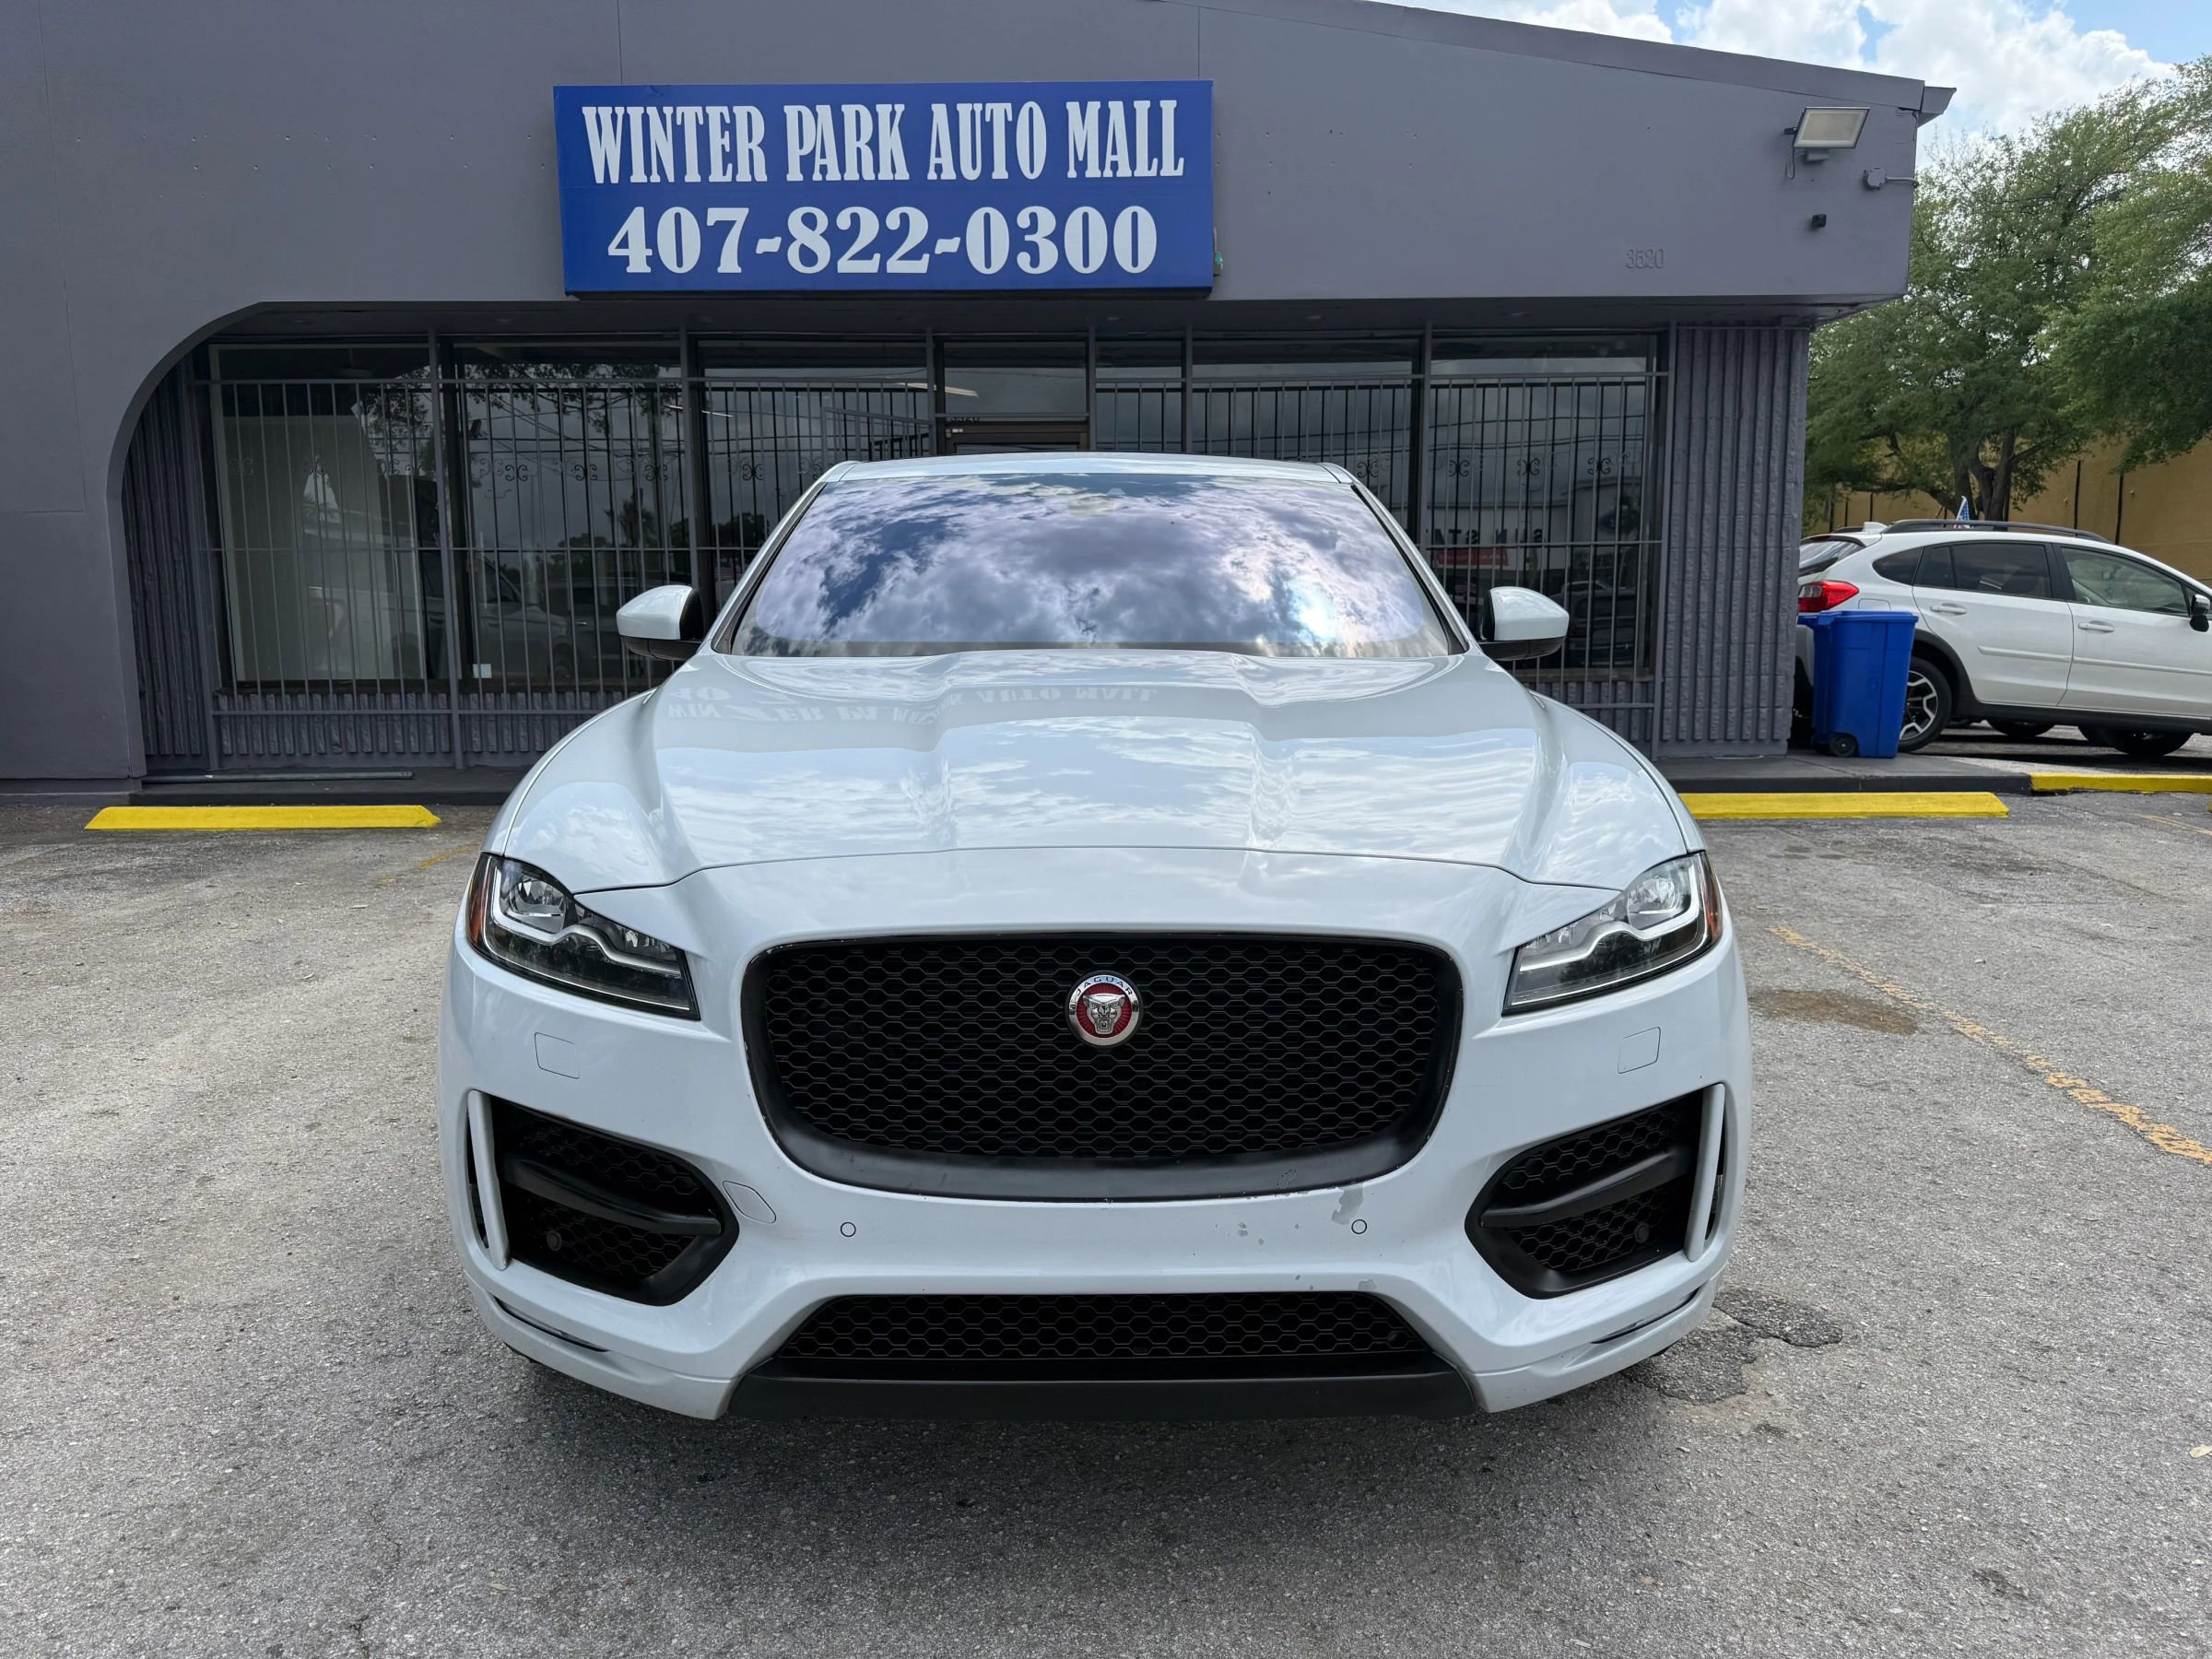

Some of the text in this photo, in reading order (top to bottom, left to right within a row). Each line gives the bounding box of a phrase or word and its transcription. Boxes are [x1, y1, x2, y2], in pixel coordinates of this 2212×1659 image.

[582, 100, 1184, 183] WINTER PARK AUTO MALL
[607, 206, 1157, 275] 407-822-0300
[1625, 248, 1665, 270] 3520
[1077, 976, 1134, 997] JAGUAR
